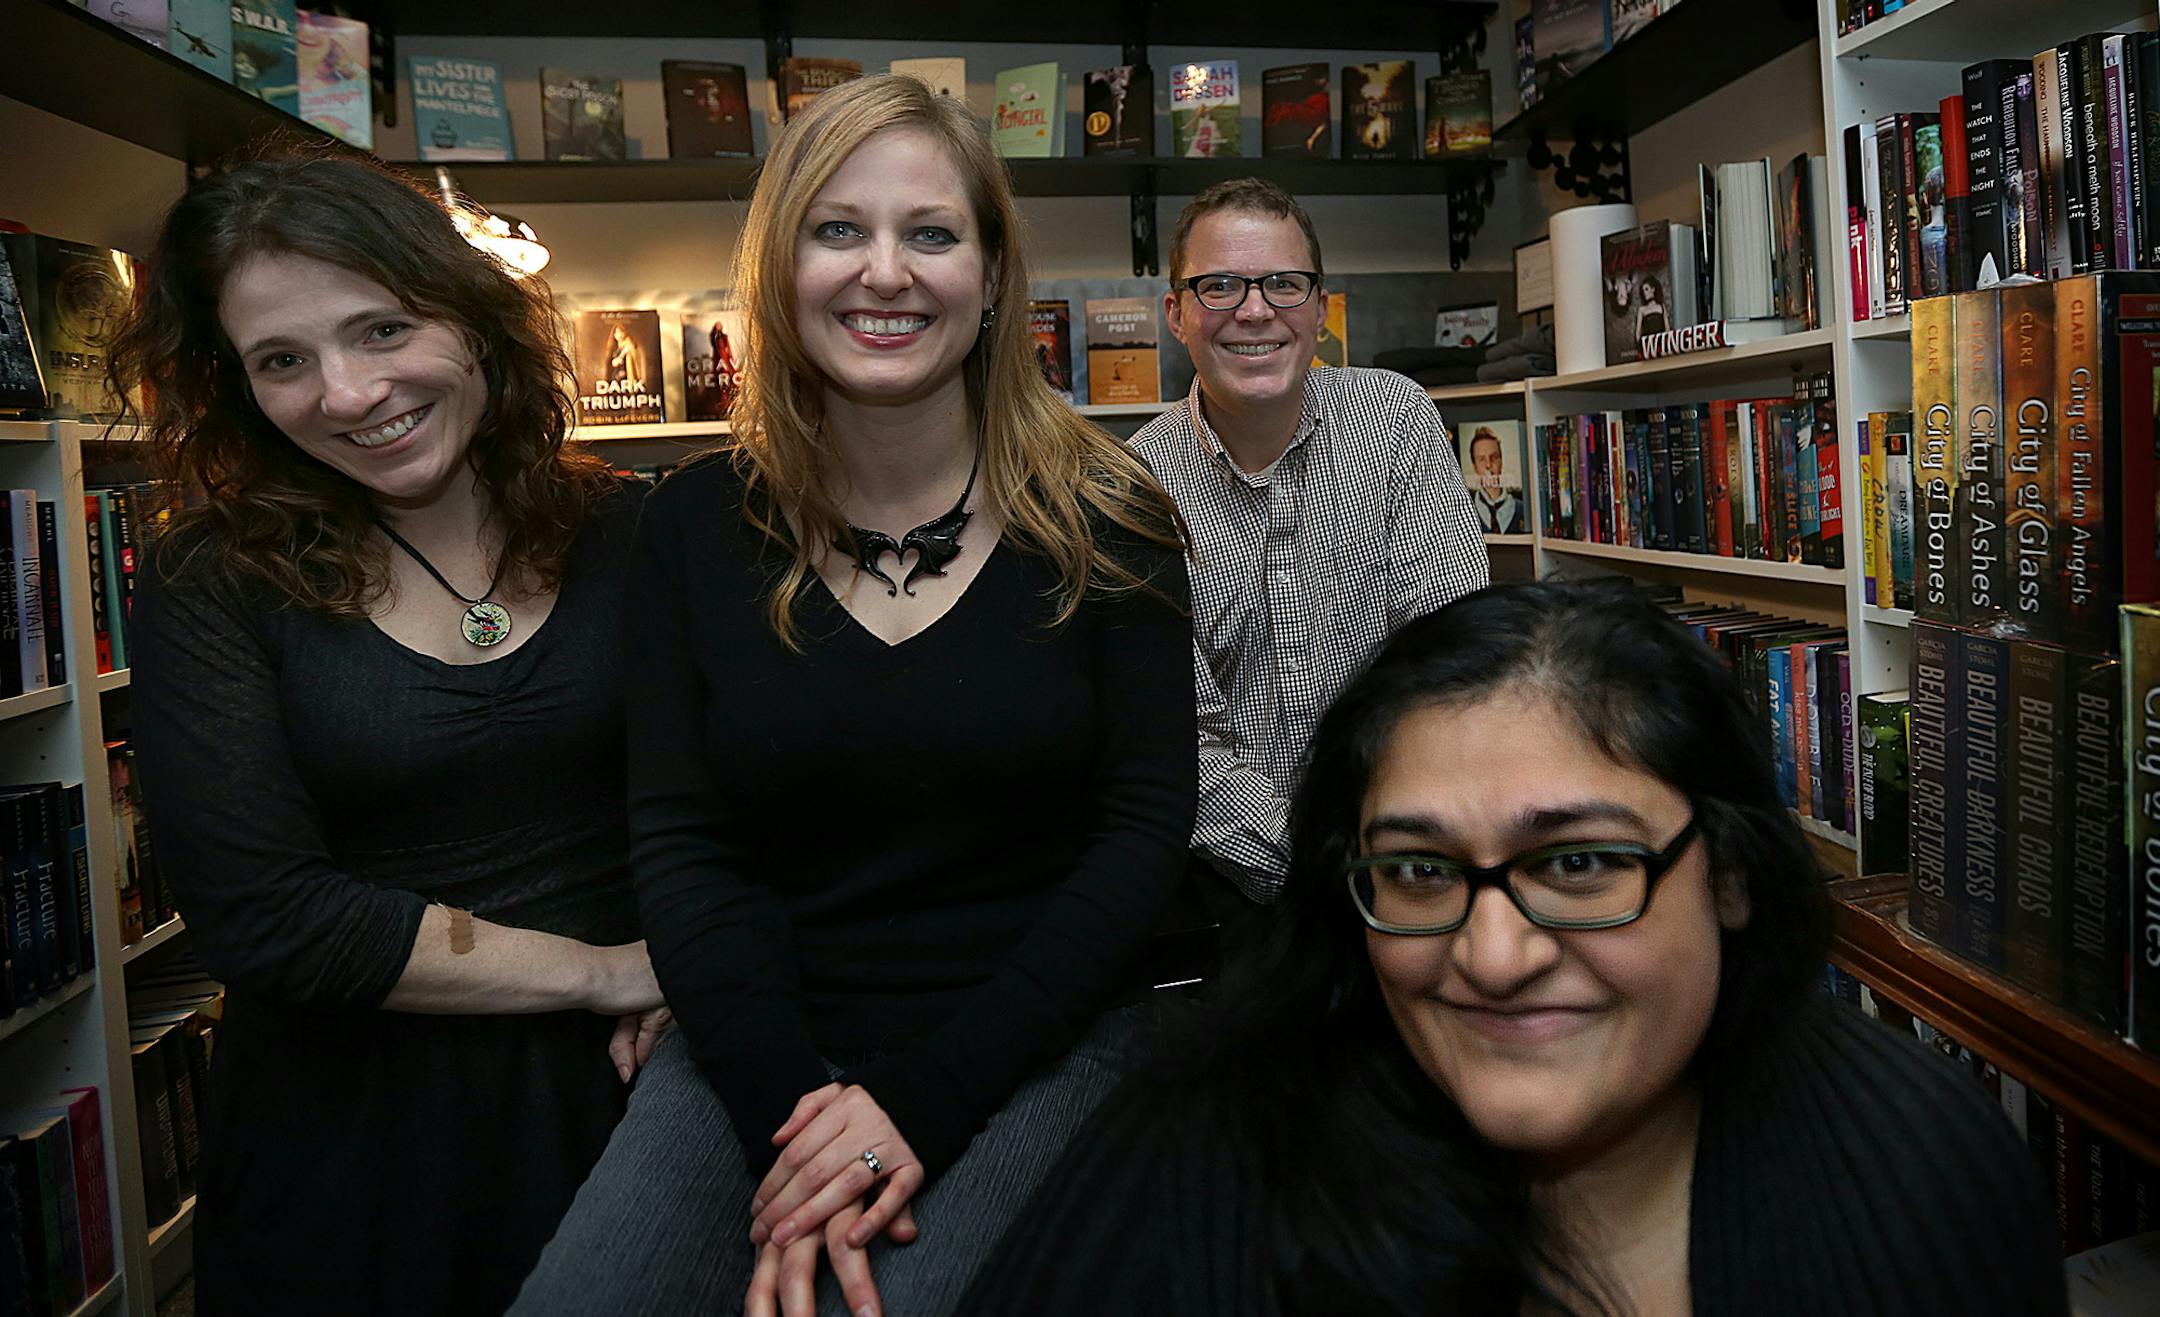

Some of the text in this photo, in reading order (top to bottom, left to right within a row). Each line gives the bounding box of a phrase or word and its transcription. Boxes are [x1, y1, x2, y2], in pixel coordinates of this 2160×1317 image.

[415, 79, 470, 98] LIVES
[436, 60, 496, 82] SISTER
[1173, 65, 1233, 86] SAH
[1173, 82, 1234, 103] DSSEN
[1971, 102, 1983, 111] THE
[2057, 51, 2075, 158] JACQUELINE WOODSON
[2127, 92, 2136, 128] BLACK
[1966, 115, 1993, 129] WATCH
[1971, 133, 1988, 144] THAT
[2001, 84, 2020, 178] RETRIBUTION FALLS
[2110, 116, 2121, 149] WOODSON
[1970, 148, 1992, 161] ENDS
[1975, 166, 1987, 176] THE
[2083, 101, 2101, 231] beneath a meth moon
[2131, 131, 2141, 207] HELICOPTERS
[1971, 180, 1995, 193] NIGHT
[1848, 206, 1864, 249] pink
[2010, 223, 2020, 269] WOODING
[1095, 313, 1149, 323] CAMERON
[1108, 324, 1136, 333] POST
[2070, 299, 2084, 353] CLARE
[1641, 320, 1719, 360] WINGER
[1927, 324, 1939, 376] CLARE
[1971, 320, 1985, 372] CLARE
[2019, 311, 2033, 367] CLARE
[687, 358, 742, 373] GRAV
[688, 374, 745, 388] MERC
[580, 394, 662, 411] TRIUMPH
[595, 379, 646, 395] DARK
[1819, 474, 1836, 492] LOOD
[2065, 366, 2092, 606] City of Fallen Angels
[1787, 492, 1798, 530] SLICE
[1921, 403, 1952, 605] City of Bones
[1964, 404, 1998, 608] City of Ashes
[2010, 397, 2049, 614] City of Glass
[22, 556, 45, 644] INCARNATE
[1768, 679, 1780, 711] FAT
[1794, 691, 1805, 716] kiss
[1796, 717, 1803, 735] me
[1917, 663, 1946, 771] BEAUTIFUL
[1966, 668, 1998, 784] BEAUTIFUL
[2018, 695, 2054, 827] BEAUTIFUL
[1917, 779, 1946, 898] CREATURES
[1965, 782, 1998, 904] DARKNESS
[2072, 690, 2111, 961] BEAUTIFUL REDEMPTION
[2017, 832, 2053, 919] CHAOS
[13, 868, 33, 952] Fracture
[38, 860, 57, 941] Fracture
